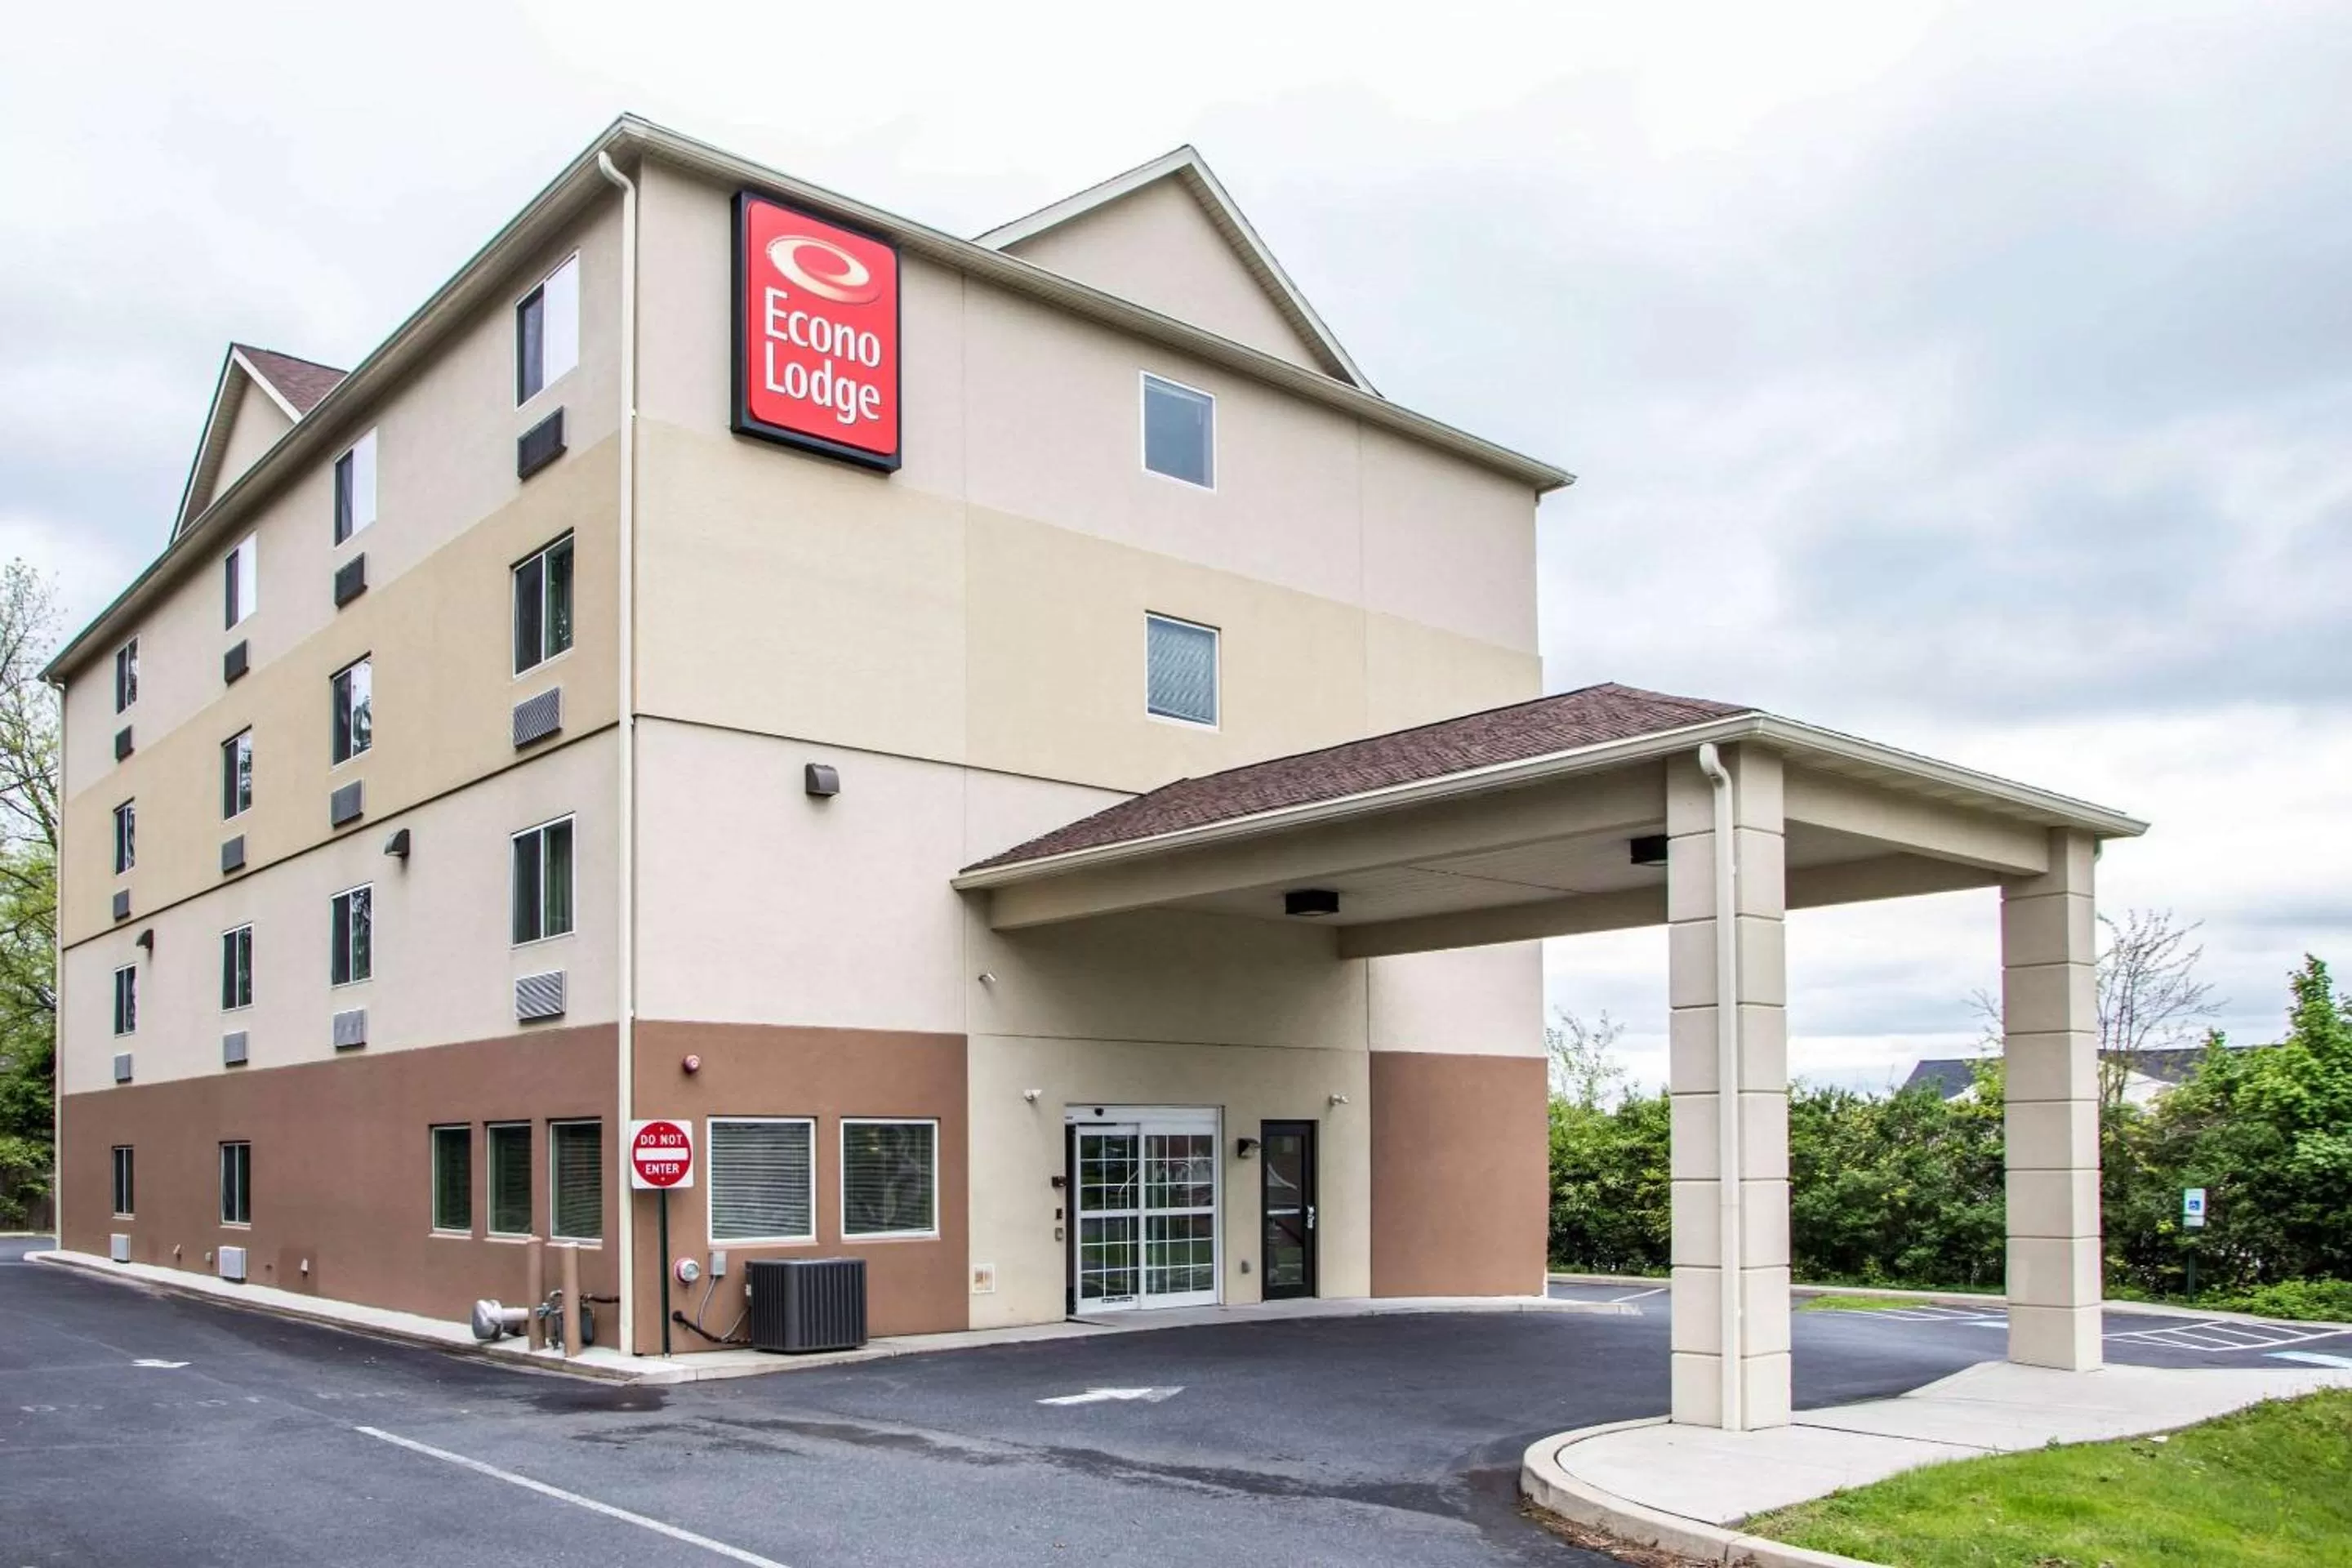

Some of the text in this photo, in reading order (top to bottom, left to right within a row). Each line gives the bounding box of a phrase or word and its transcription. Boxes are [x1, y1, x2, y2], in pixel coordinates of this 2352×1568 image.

[764, 286, 881, 368] Econo
[764, 340, 881, 425] Lodge
[640, 1134, 683, 1145] DO NOT
[645, 1163, 679, 1174] ENTER
